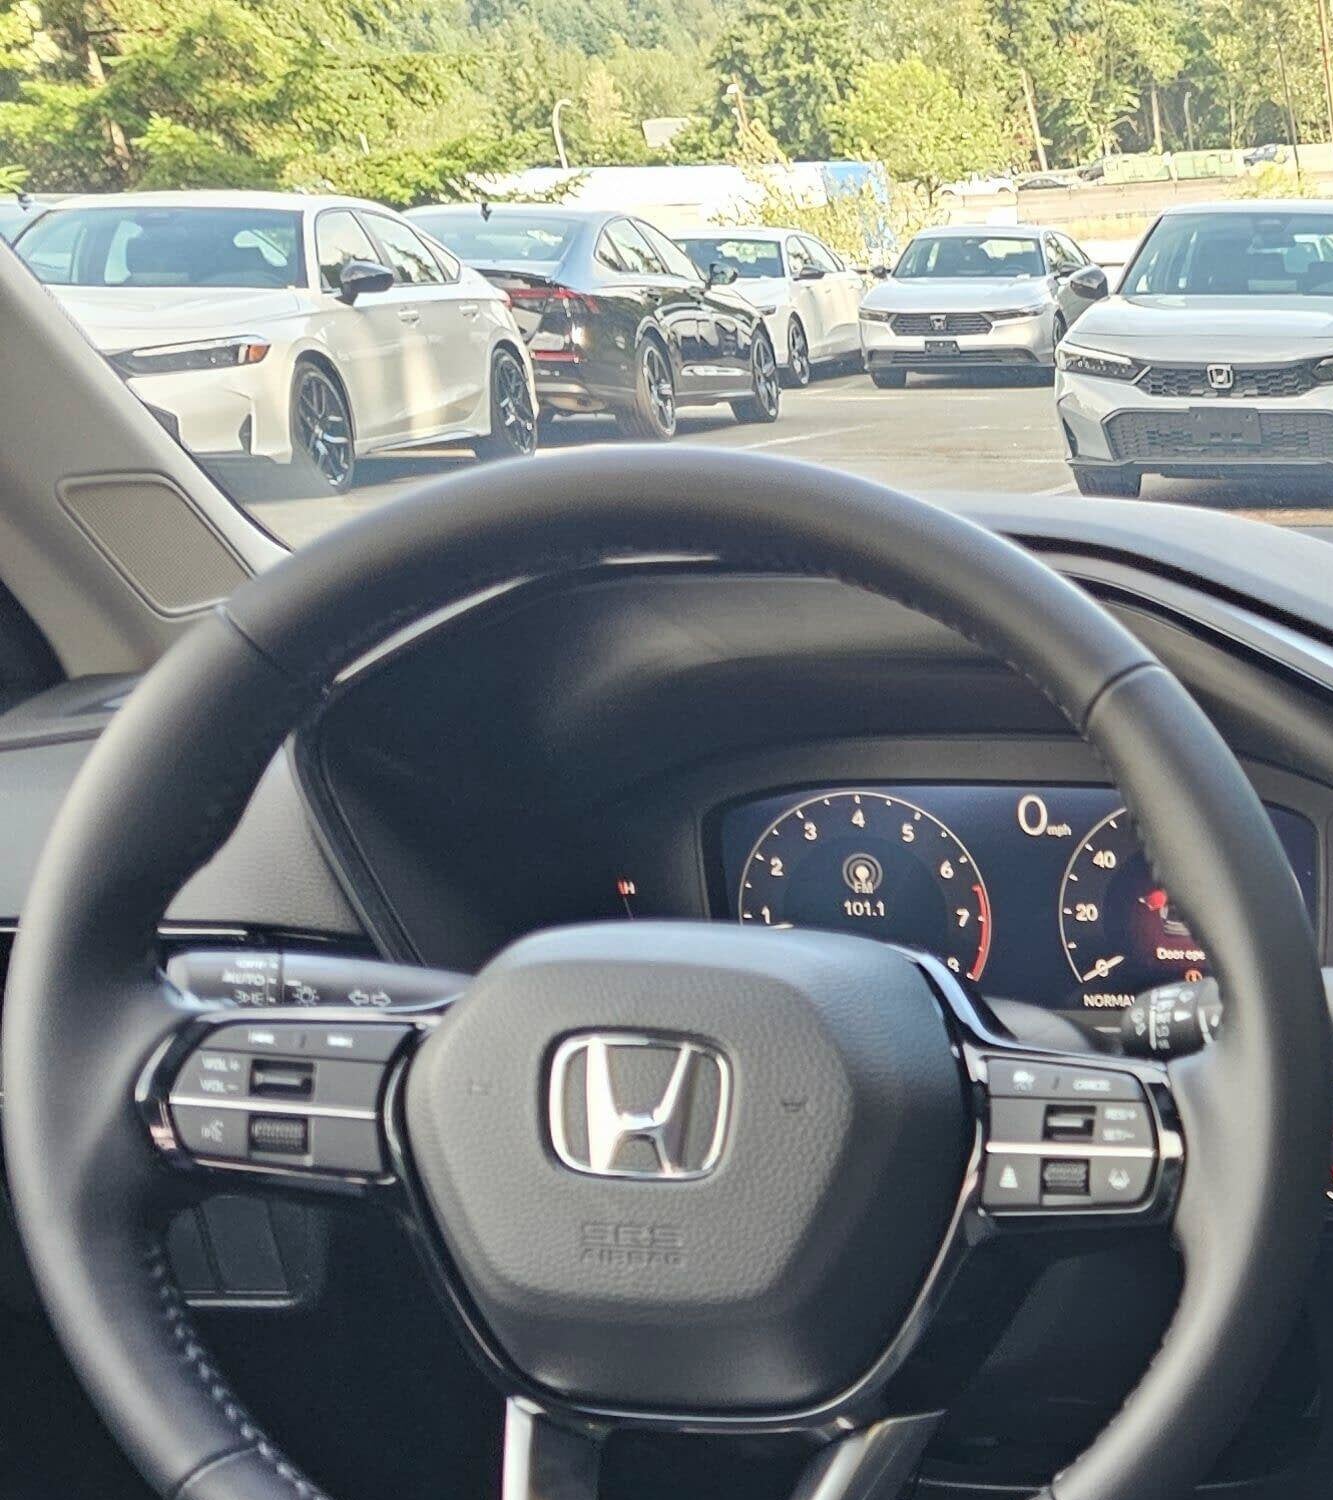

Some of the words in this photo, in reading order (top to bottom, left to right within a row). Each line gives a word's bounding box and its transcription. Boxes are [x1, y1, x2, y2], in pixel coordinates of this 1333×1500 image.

[852, 809, 866, 829] 4
[1017, 794, 1048, 837] 0
[1046, 823, 1072, 838] mph
[803, 821, 818, 841] 3
[902, 822, 916, 843] 5
[770, 856, 784, 877] 2
[1092, 850, 1117, 869] 40
[939, 860, 955, 880] 6
[761, 905, 771, 925] 1
[844, 900, 885, 917] 101.1
[956, 907, 971, 928] 7
[1075, 903, 1099, 922] 20
[1156, 947, 1185, 961] Door
